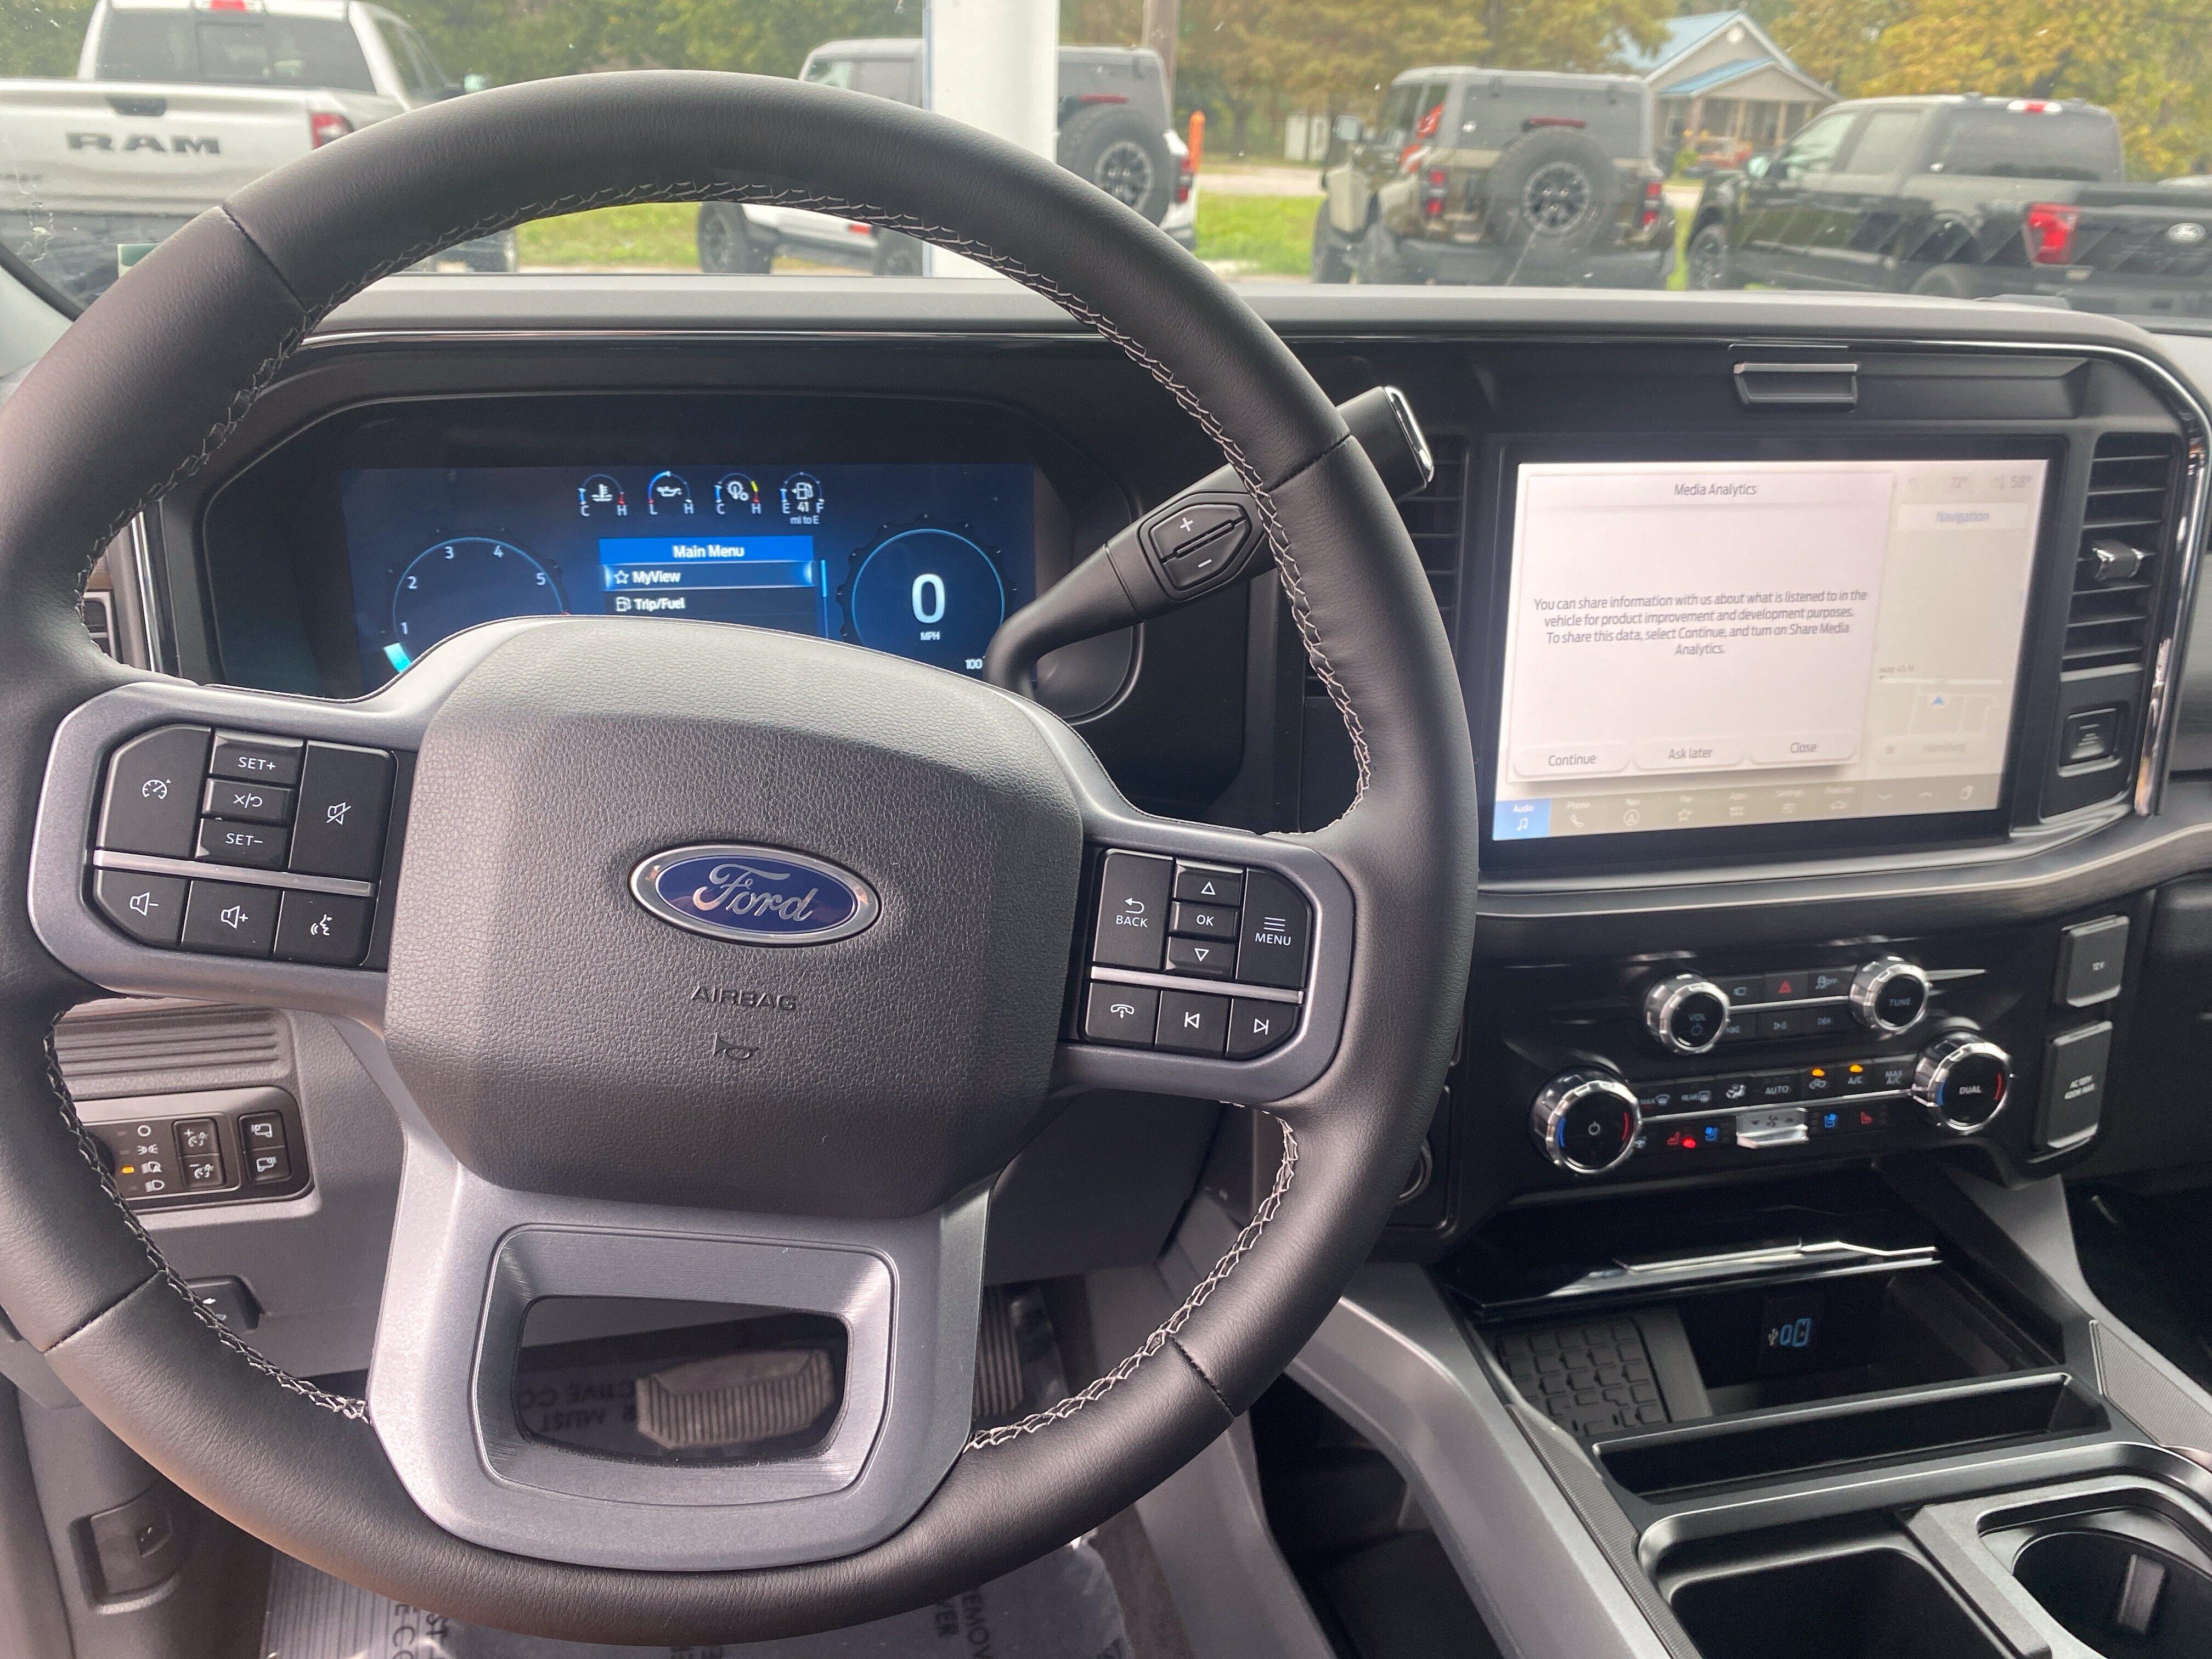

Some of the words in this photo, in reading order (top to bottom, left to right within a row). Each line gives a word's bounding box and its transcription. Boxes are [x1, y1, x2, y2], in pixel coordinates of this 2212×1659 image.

[65, 132, 222, 155] RAM
[1674, 483, 1706, 496] Media
[1708, 483, 1757, 497] Analytics
[580, 505, 590, 517] C
[617, 505, 627, 516] H
[649, 504, 658, 515] L
[684, 503, 693, 515] H
[716, 504, 725, 515] C
[752, 503, 761, 515] H
[782, 503, 790, 515] E
[797, 501, 809, 513] 41
[816, 502, 824, 514] F
[444, 546, 454, 560] 3
[493, 544, 504, 558] 4
[673, 544, 706, 558] Main
[708, 544, 745, 557] Menu
[407, 575, 418, 590] 2
[535, 571, 546, 586] 5
[632, 570, 681, 586] MyView
[633, 597, 686, 612] Trip/Fuel
[911, 572, 946, 624] 0
[1534, 597, 1554, 611] You
[1556, 599, 1576, 610] can
[1578, 597, 1607, 609] share
[1610, 595, 1673, 608] information
[1675, 594, 1699, 606] with
[1700, 596, 1712, 605] us
[1714, 592, 1745, 605] about
[1747, 592, 1773, 604] what
[1775, 591, 1783, 603] is
[1785, 590, 1825, 603] listened
[1826, 591, 1837, 602] to
[1839, 590, 1848, 601] in
[1850, 589, 1867, 601] the
[1544, 613, 1582, 628] vehicle
[1584, 613, 1599, 626] for
[1601, 613, 1643, 628] product
[1645, 610, 1715, 625] improvement
[1717, 607, 1736, 621] and
[1738, 605, 1805, 622] development
[1807, 606, 1854, 621] purposes.
[400, 622, 409, 635] 1
[919, 630, 940, 641] MPH
[1547, 631, 1560, 644] To
[1561, 630, 1592, 643] share
[1594, 629, 1613, 641] this
[1616, 629, 1643, 642] data,
[1645, 628, 1676, 640] select
[1678, 626, 1727, 640] Continue,
[1729, 625, 1749, 637] and
[1751, 625, 1772, 636] turn
[1774, 625, 1787, 636] on
[1789, 623, 1818, 635] Share
[1820, 622, 1850, 634] Media
[1674, 642, 1725, 657] Analytics.
[964, 658, 983, 670] 100
[1668, 748, 1686, 760] Ask
[1689, 747, 1713, 759] later
[1790, 741, 1818, 754] Close
[238, 755, 276, 771] SET+
[1548, 754, 1596, 768] Continue
[1513, 804, 1535, 814] Audio
[225, 832, 263, 847] SET-
[692, 863, 820, 923] Ford
[1115, 914, 1148, 928] BACK
[1195, 914, 1215, 927] OK
[1254, 932, 1291, 946] MENU
[690, 986, 797, 1011] AIRBAG
[1688, 1013, 1707, 1023] VOL
[1764, 1085, 1790, 1096] AUTO
[1959, 1085, 1982, 1096] DUAL
